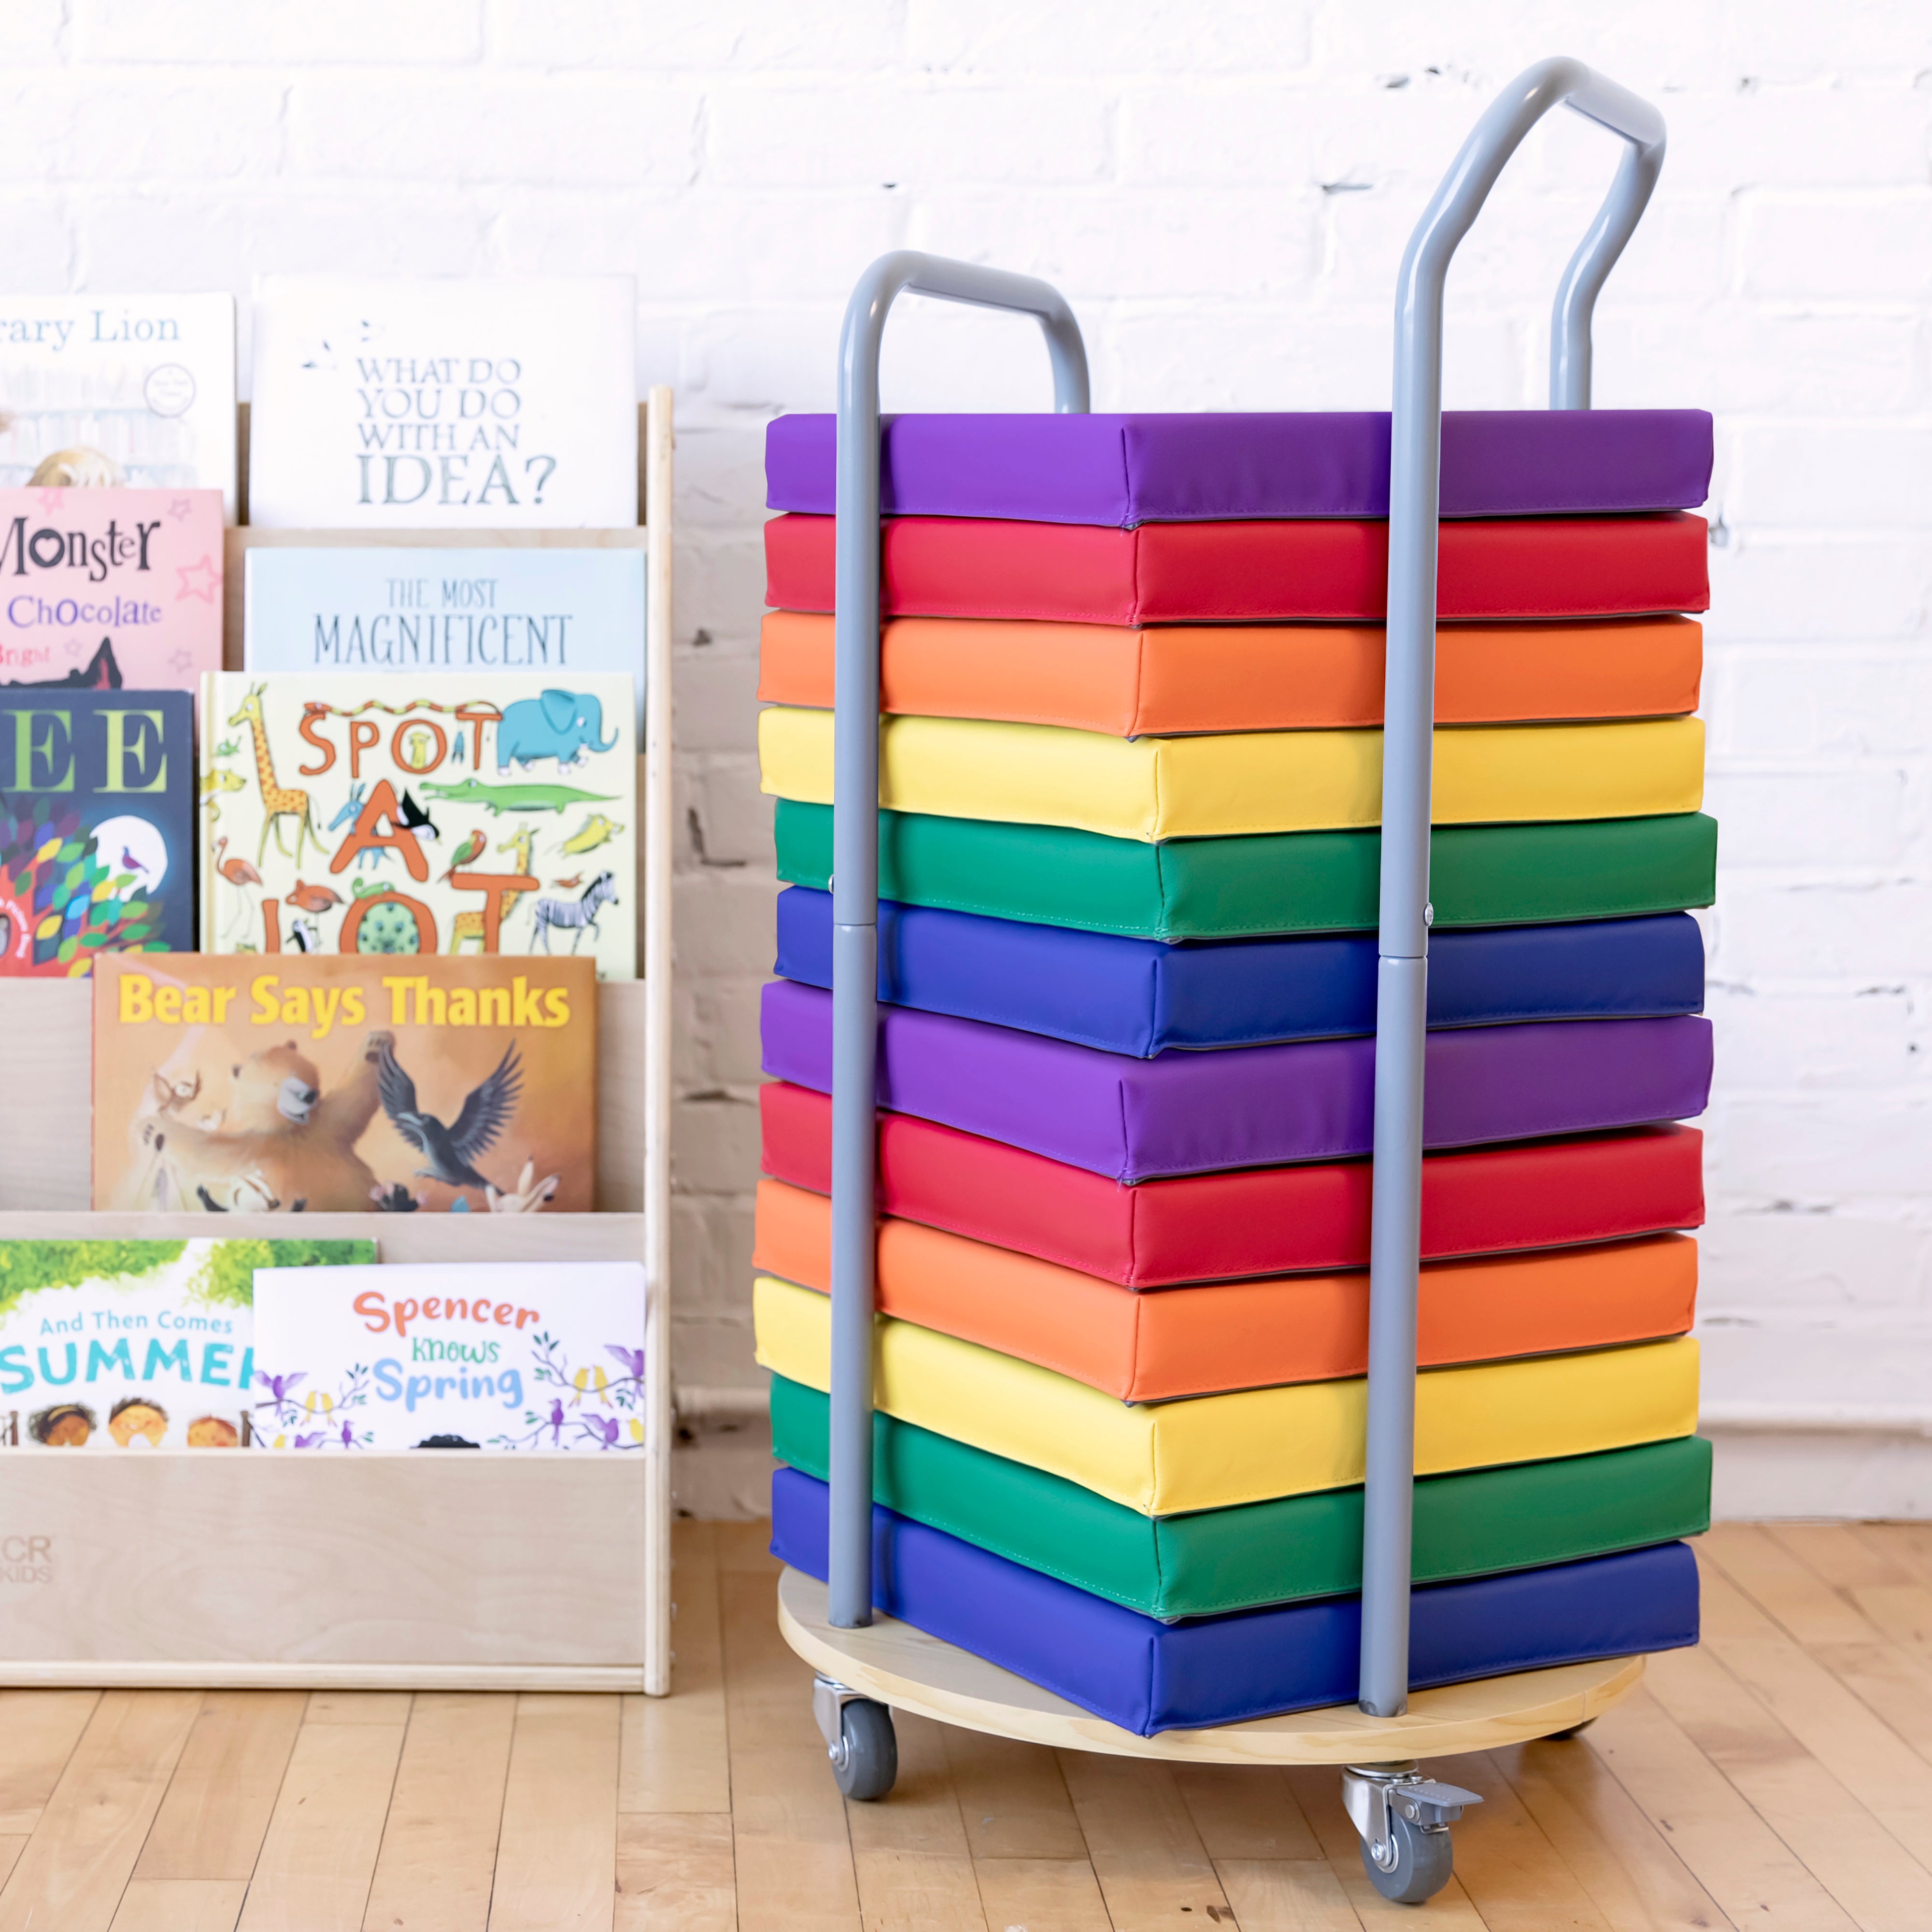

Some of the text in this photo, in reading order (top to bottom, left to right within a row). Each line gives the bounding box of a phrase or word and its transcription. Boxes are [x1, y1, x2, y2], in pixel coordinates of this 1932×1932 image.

[90, 310, 180, 341] Lion
[356, 358, 521, 384] WHAT DO
[357, 389, 521, 419] YOU DO
[357, 423, 520, 451] WITH AN
[356, 454, 557, 505] IDEA?
[386, 579, 499, 609] THE MOST
[313, 614, 573, 665] MAGNIFICENT
[299, 711, 503, 779] SPOT
[329, 779, 429, 882] A
[119, 973, 570, 1039] Bear Says Thanks
[40, 1309, 233, 1336] And Then Comes
[353, 1291, 540, 1337] Spencer
[372, 1358, 524, 1412] Spring
